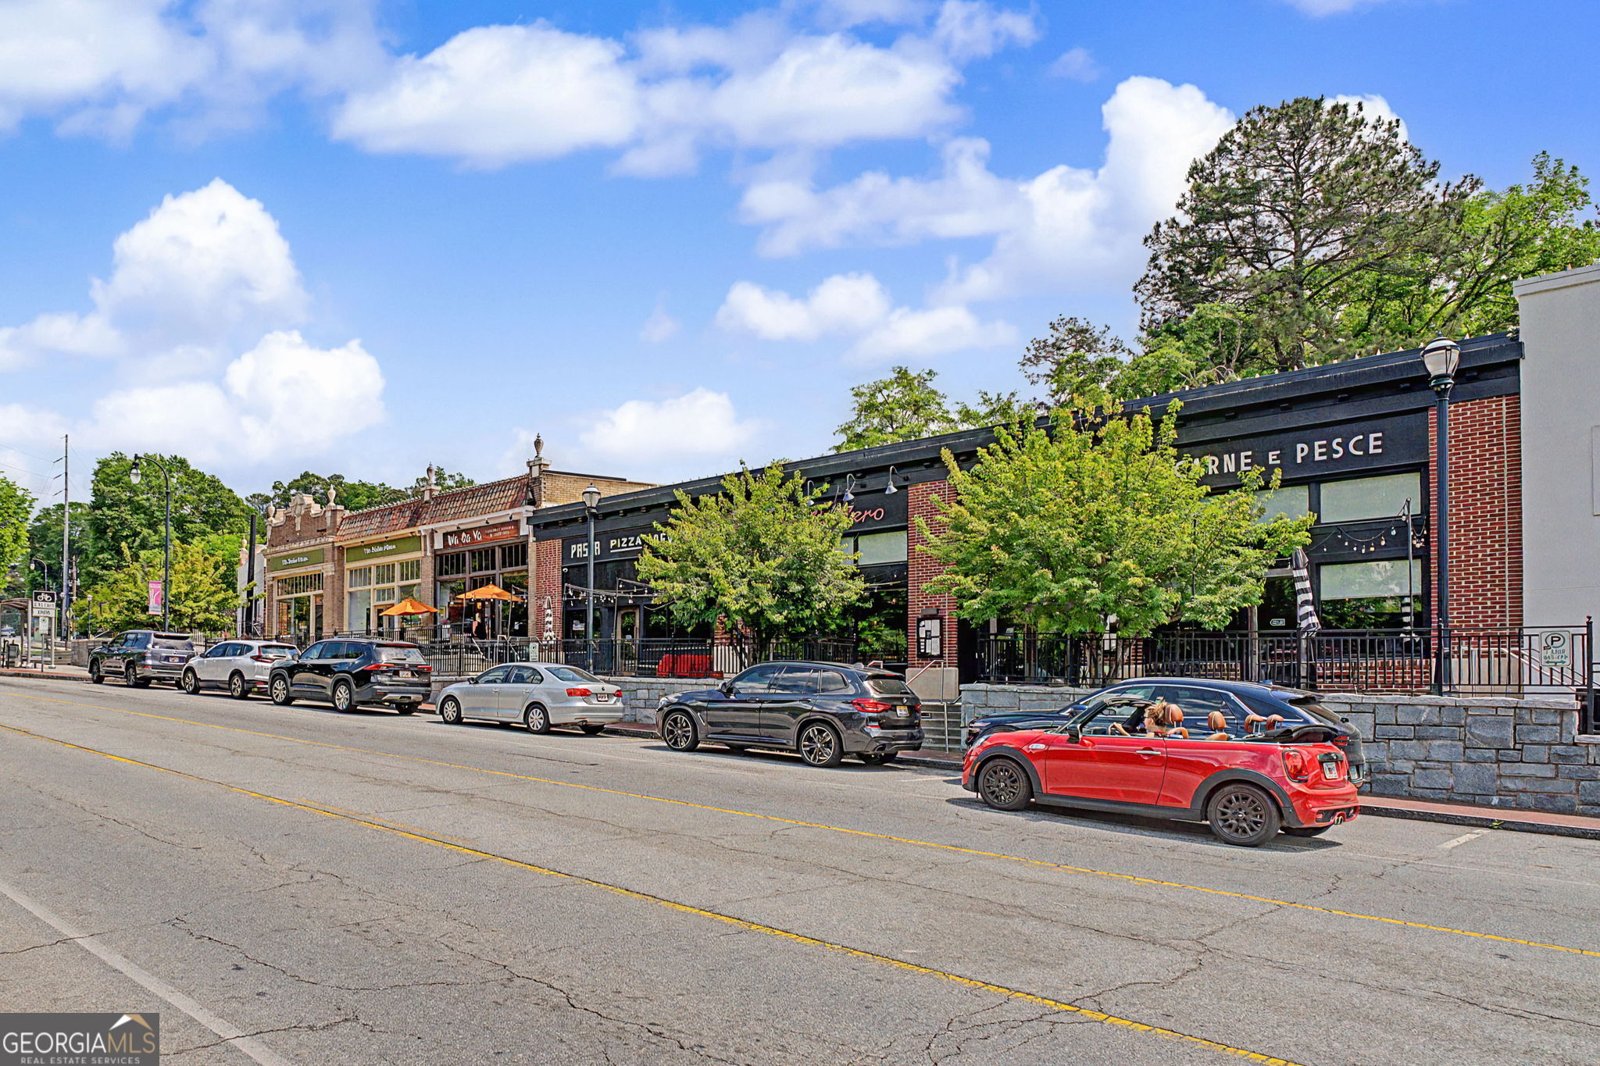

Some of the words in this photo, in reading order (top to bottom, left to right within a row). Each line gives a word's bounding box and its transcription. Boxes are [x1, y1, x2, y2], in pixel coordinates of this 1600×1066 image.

[1268, 450, 1281, 465] E
[1296, 432, 1383, 464] PESCE
[570, 540, 601, 559] PASA
[610, 536, 642, 549] PIZZA
